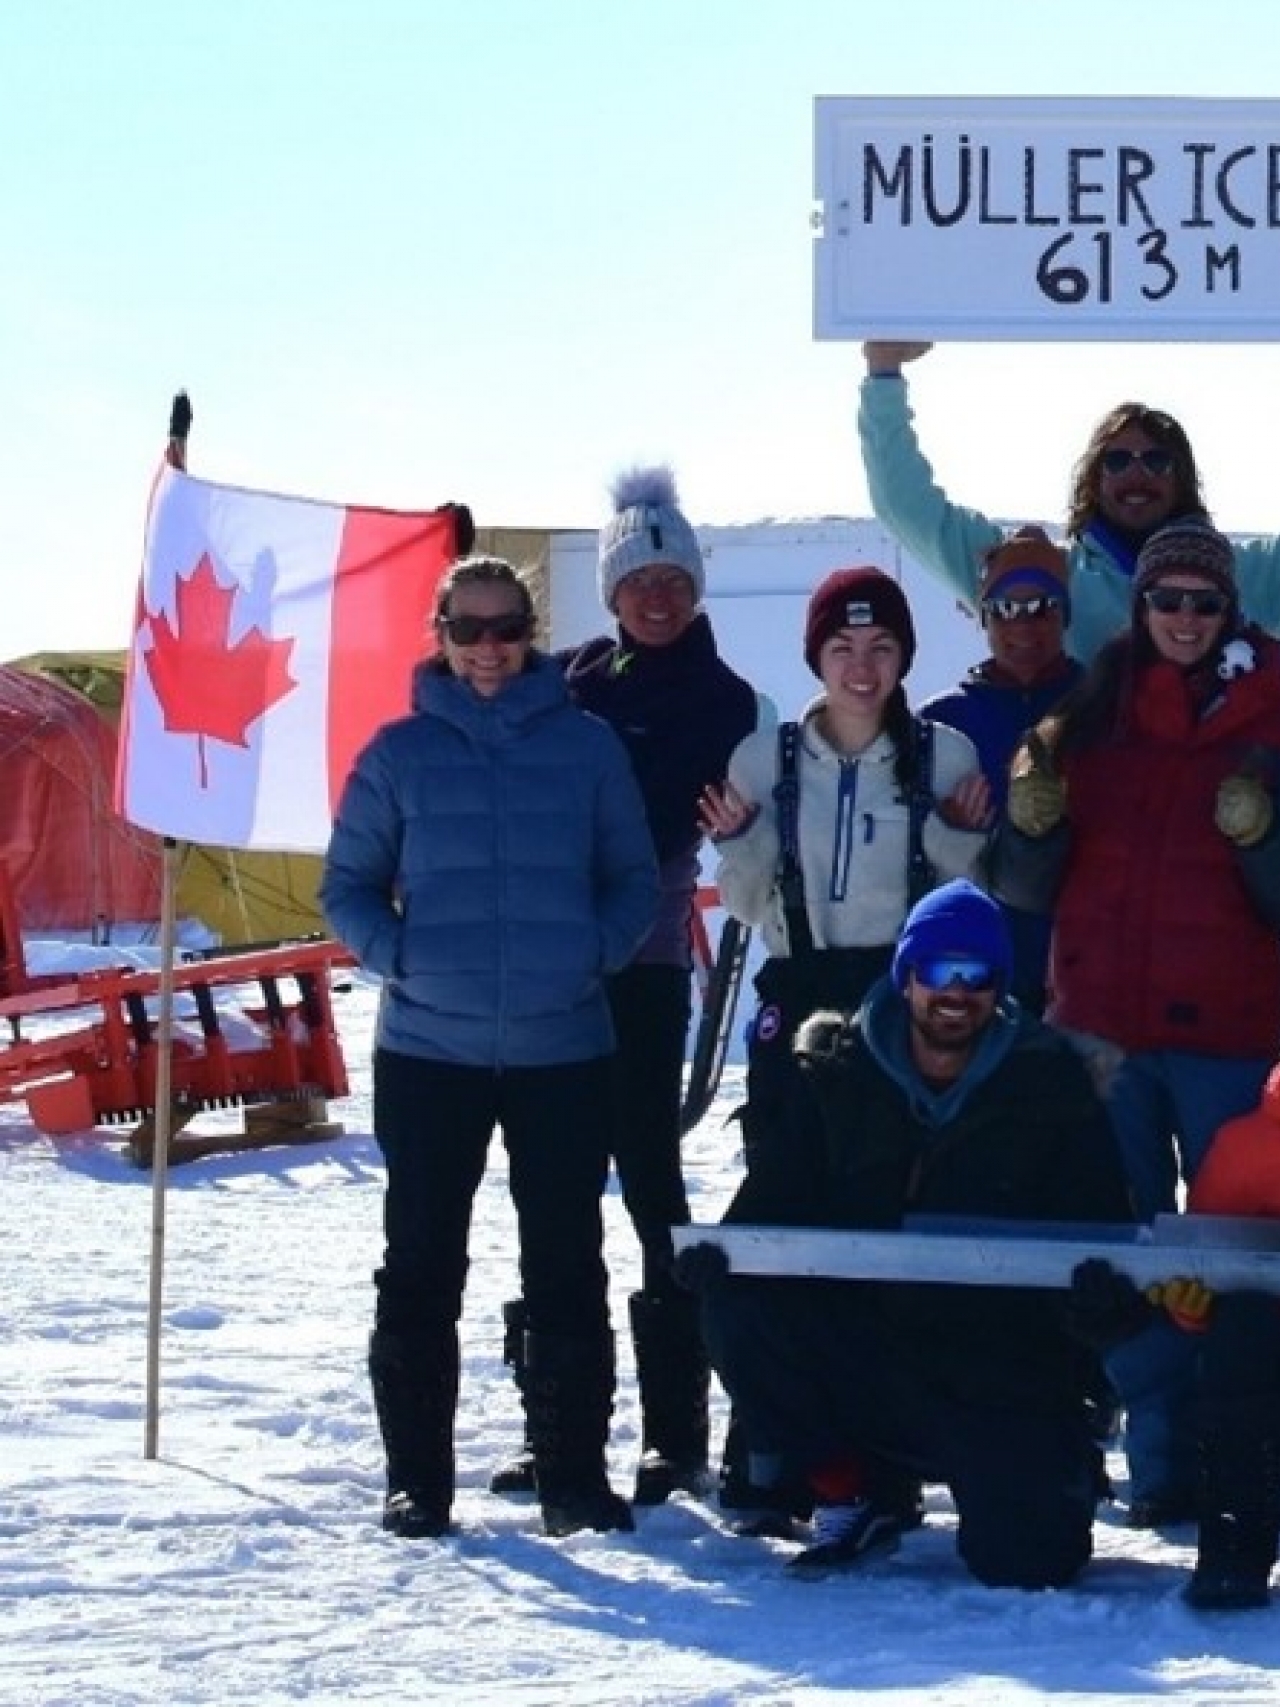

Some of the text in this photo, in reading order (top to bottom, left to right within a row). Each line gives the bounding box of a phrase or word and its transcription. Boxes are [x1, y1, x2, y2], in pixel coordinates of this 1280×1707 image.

[863, 133, 1155, 229] MÜLLER
[1036, 229, 1240, 305] 613 M
